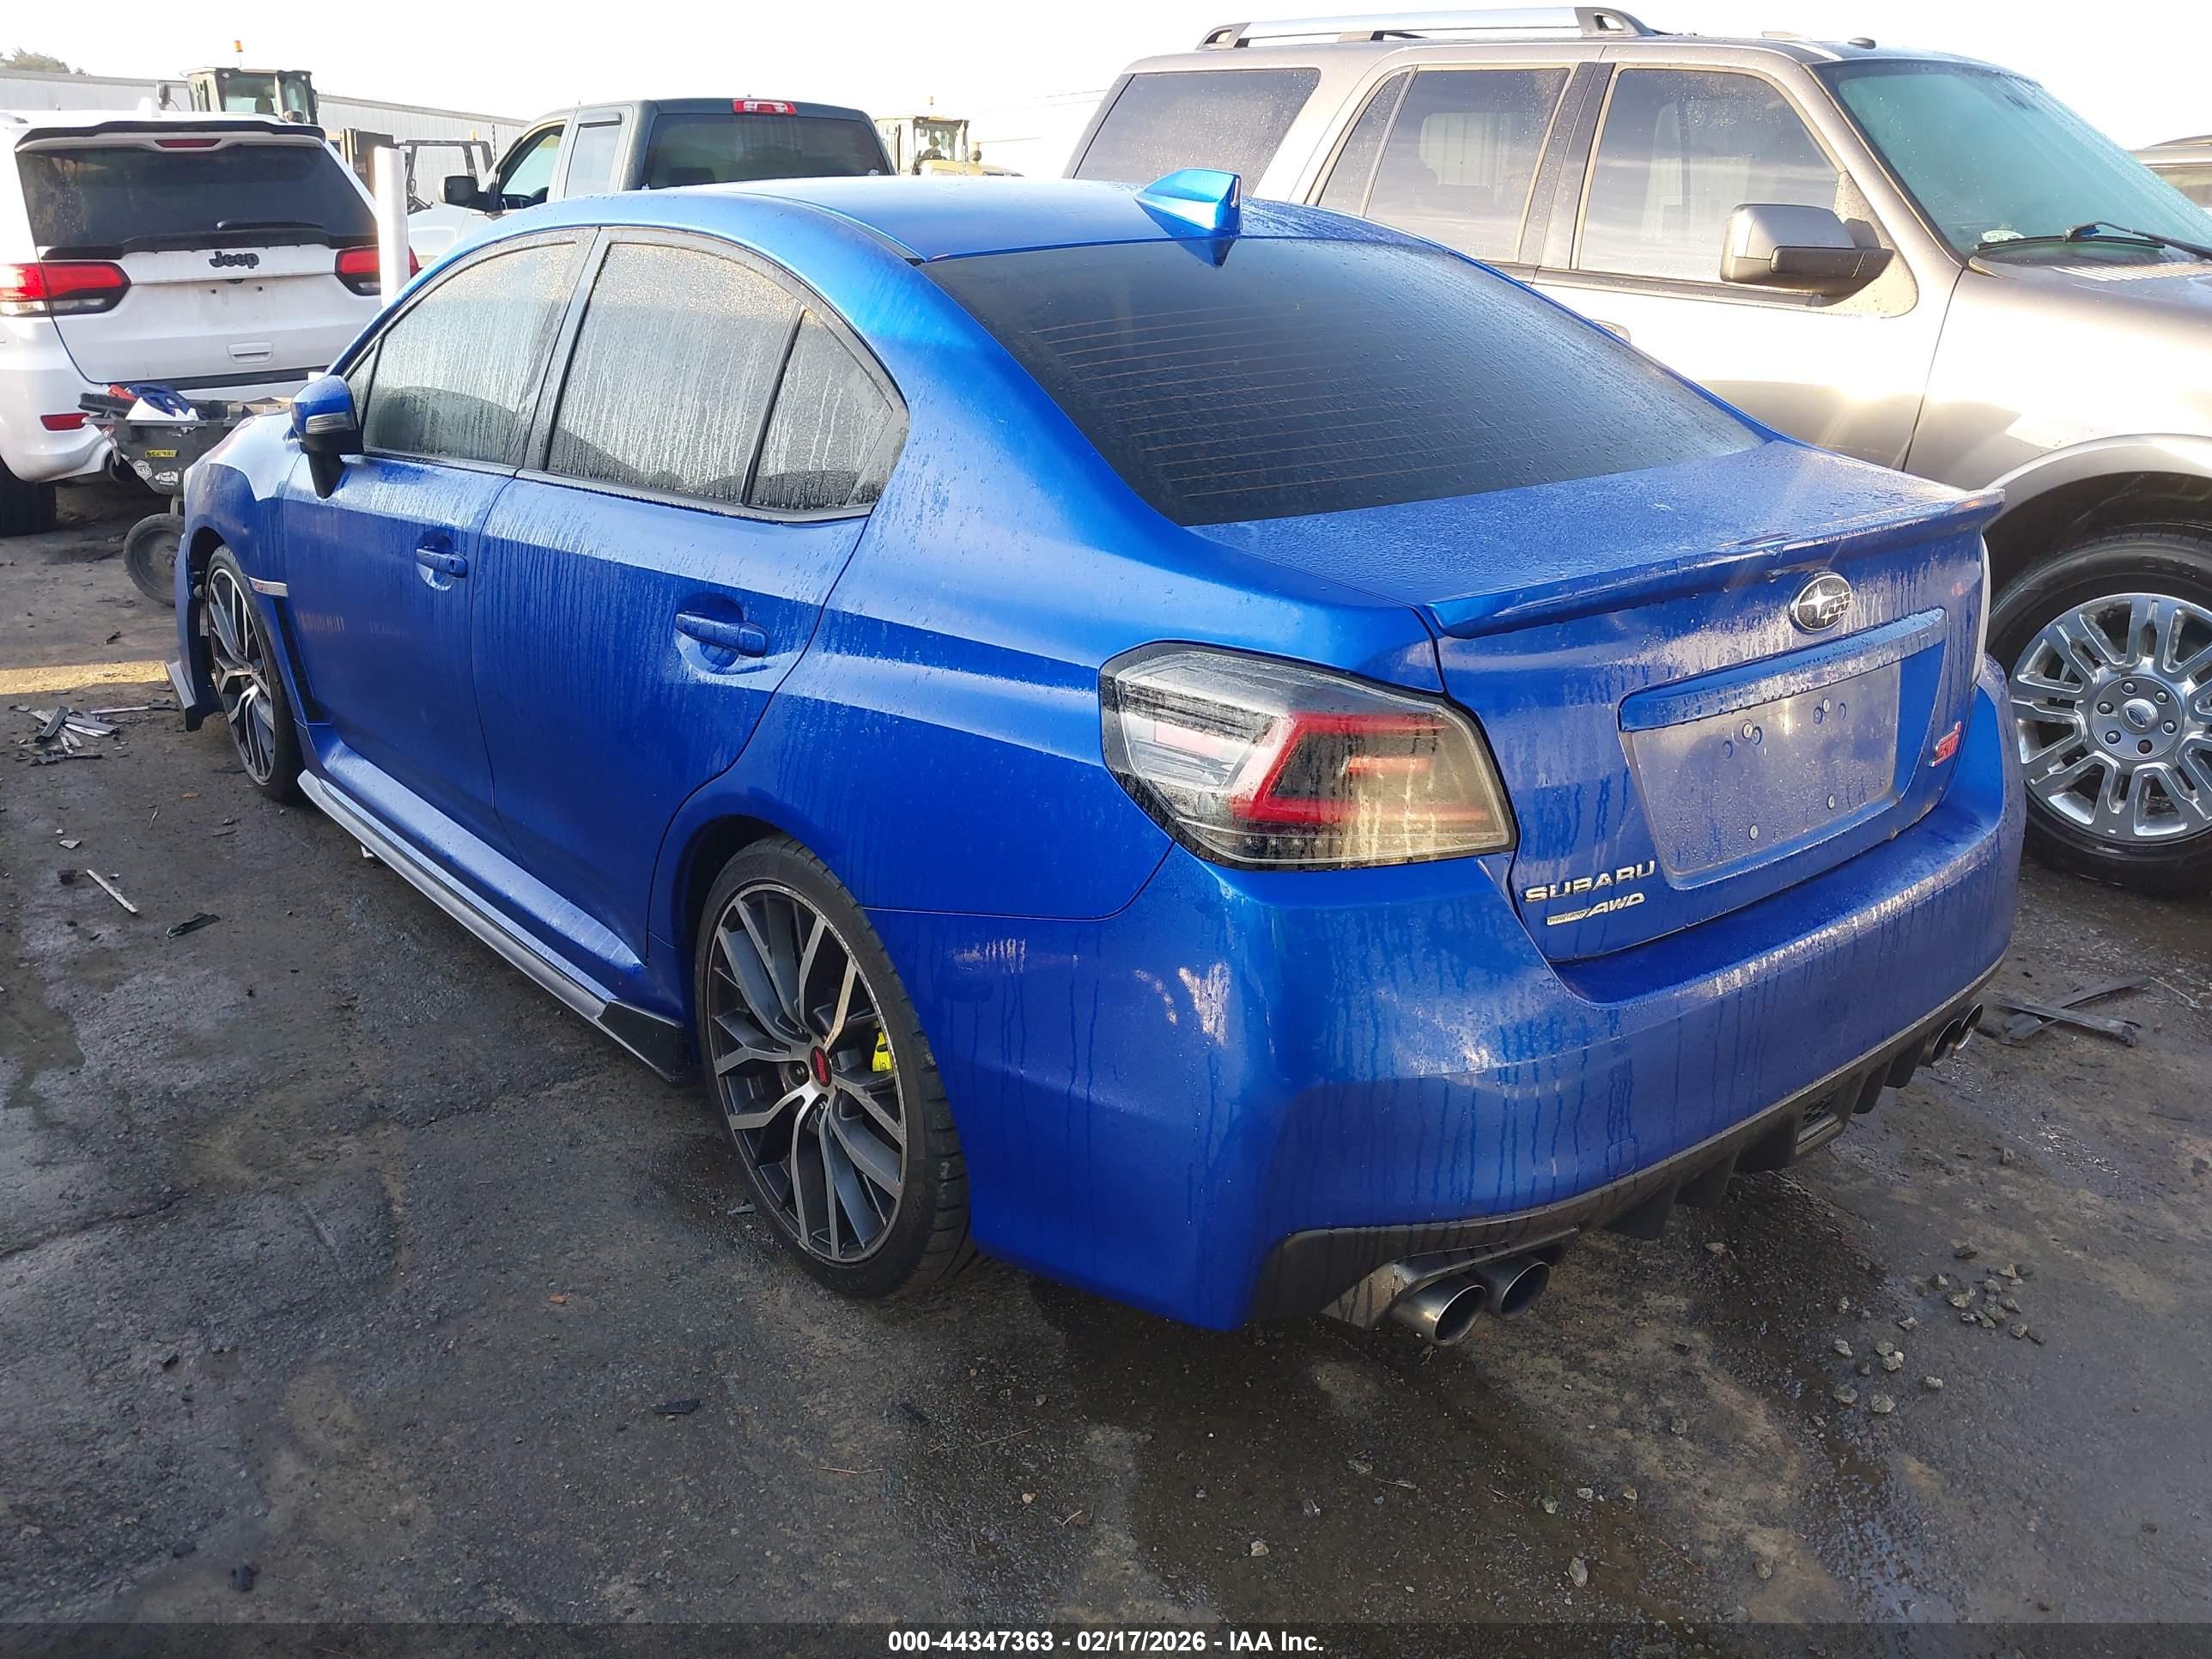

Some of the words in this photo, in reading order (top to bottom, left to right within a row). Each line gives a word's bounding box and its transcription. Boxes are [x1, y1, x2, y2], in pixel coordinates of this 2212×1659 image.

[209, 251, 260, 270] Jeep
[1525, 860, 1656, 902] SUBARU
[1588, 892, 1645, 918] AWD
